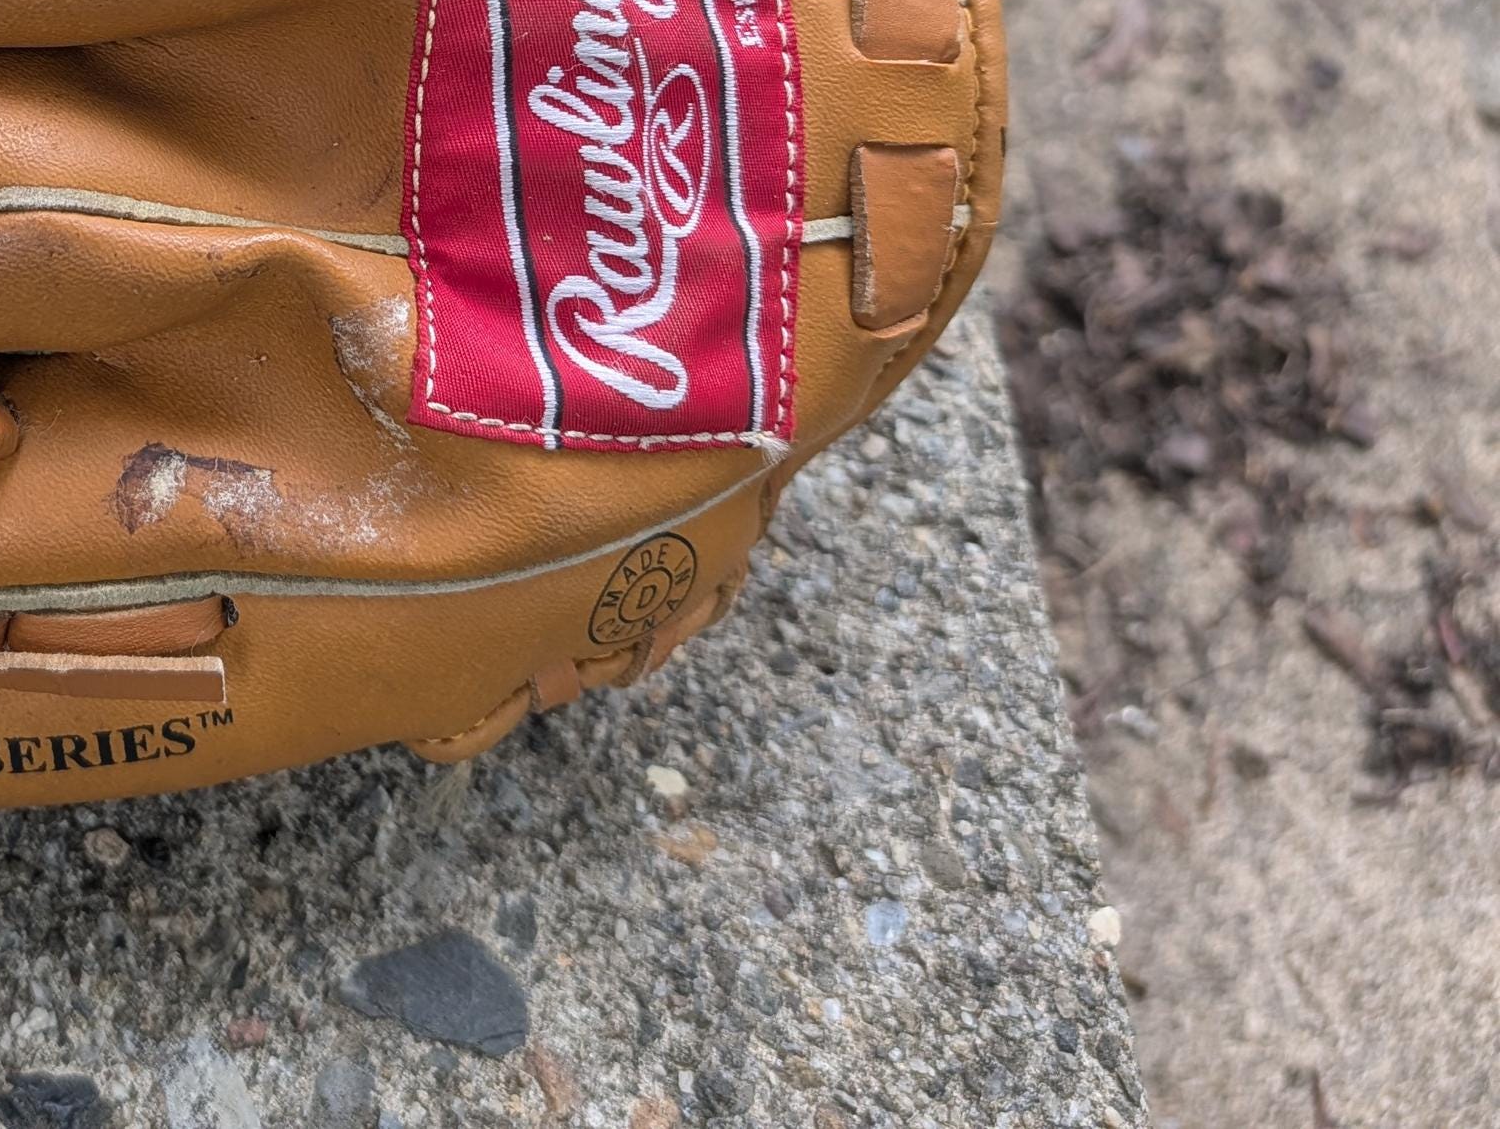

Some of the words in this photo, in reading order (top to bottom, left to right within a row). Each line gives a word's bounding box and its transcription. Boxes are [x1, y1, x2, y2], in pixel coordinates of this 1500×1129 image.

[601, 543, 669, 608] MADE
[674, 555, 692, 586] IN
[635, 584, 658, 610] D
[595, 598, 682, 640] CHINA
